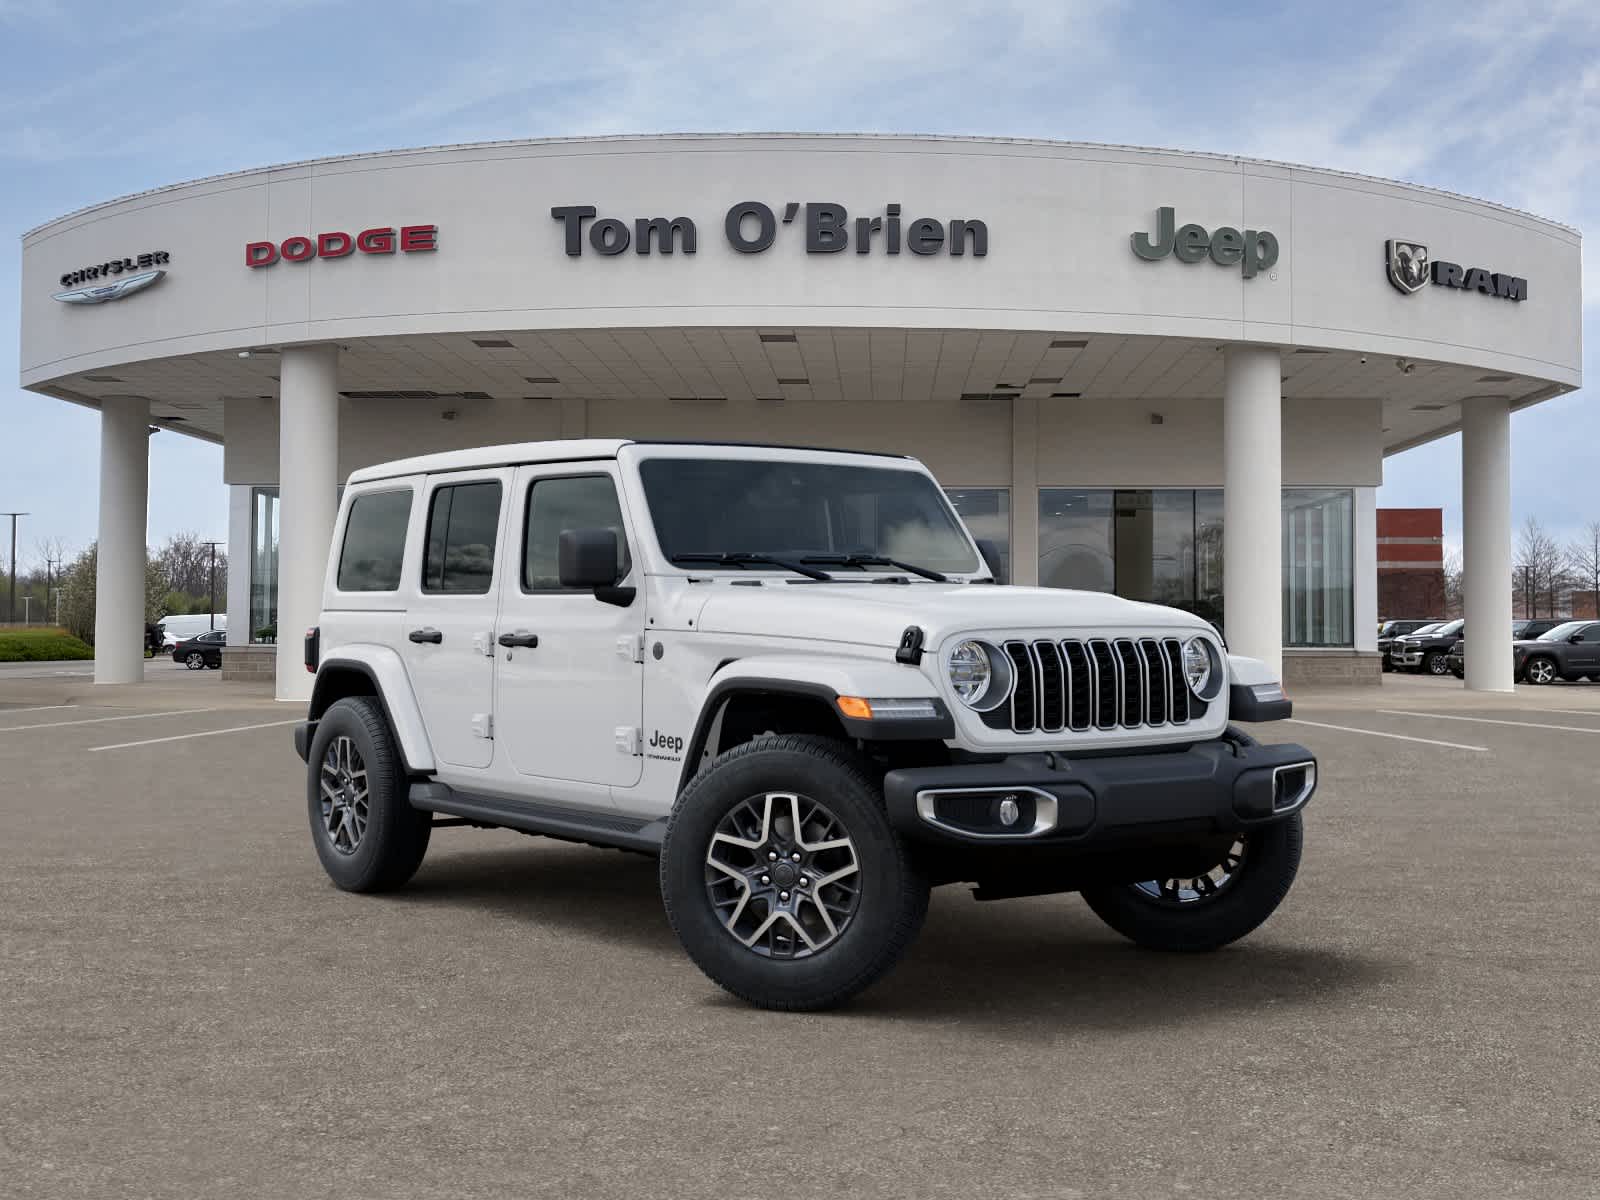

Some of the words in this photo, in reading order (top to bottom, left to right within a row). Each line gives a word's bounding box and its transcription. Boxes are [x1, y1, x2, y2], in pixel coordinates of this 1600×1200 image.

[245, 224, 438, 270] DODGE
[551, 205, 698, 257] Tom
[725, 200, 989, 257] O'Brien
[1130, 206, 1280, 280] Jeep
[60, 250, 170, 287] CHRYSLER
[1431, 260, 1528, 301] RAM
[649, 729, 684, 754] Jeep
